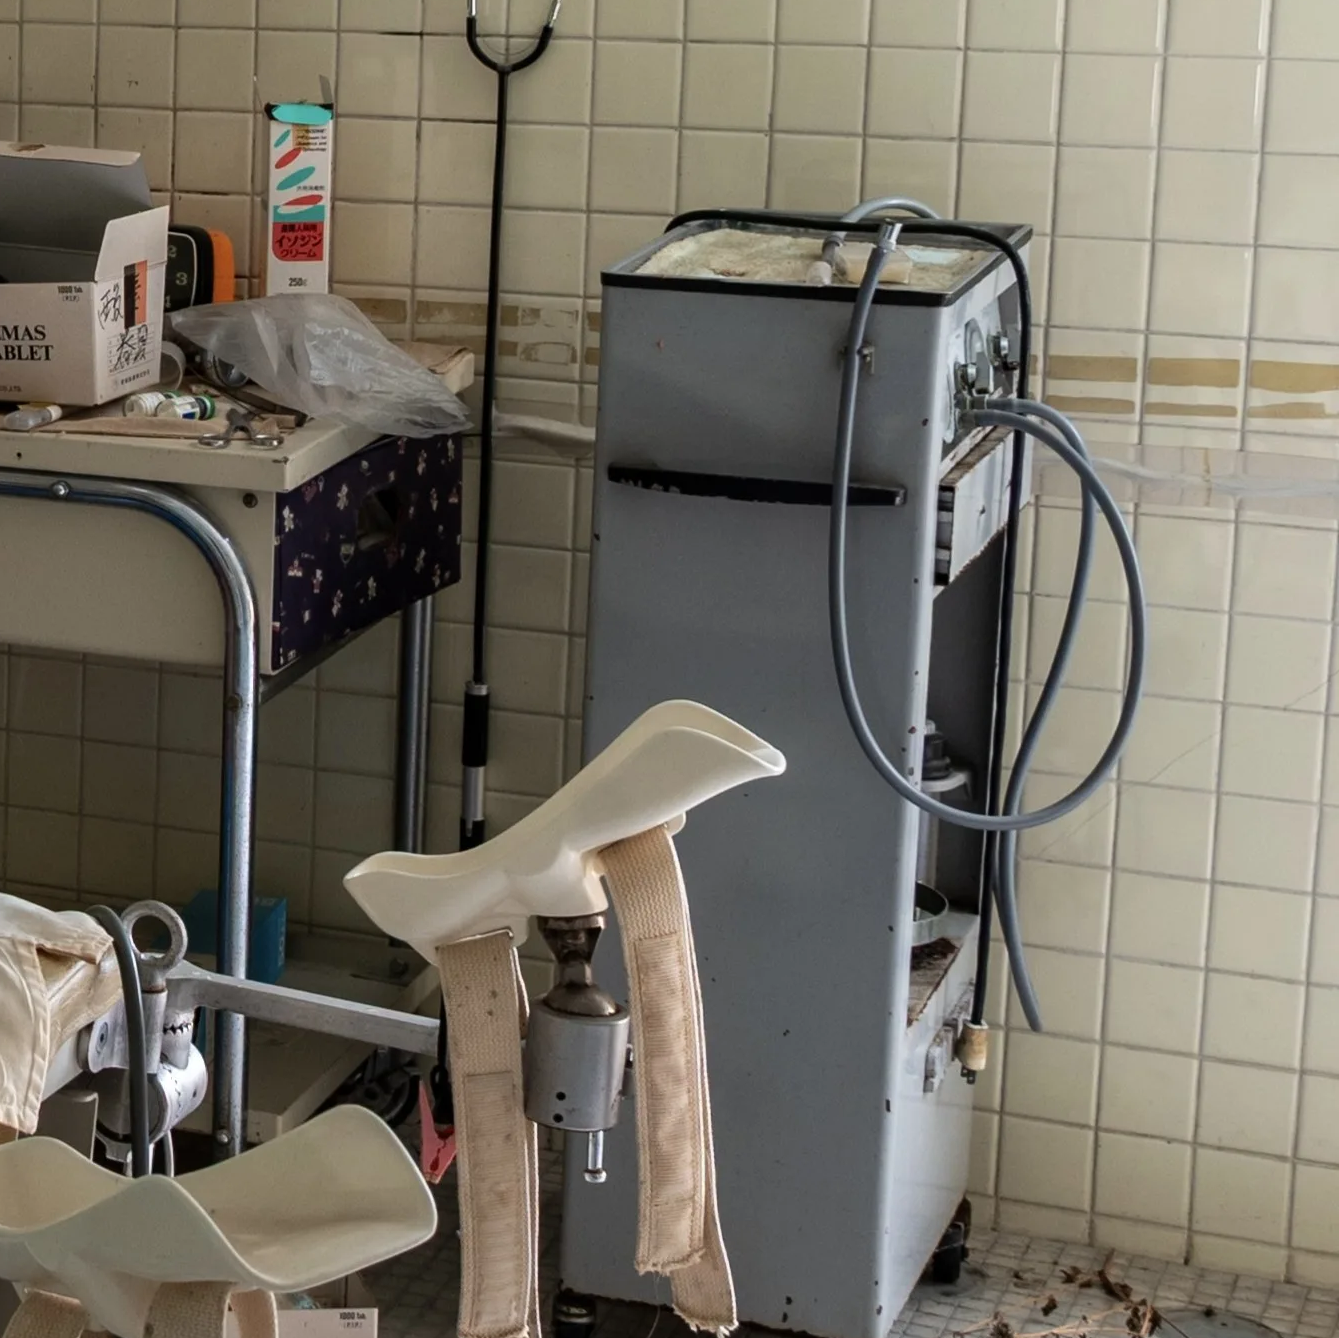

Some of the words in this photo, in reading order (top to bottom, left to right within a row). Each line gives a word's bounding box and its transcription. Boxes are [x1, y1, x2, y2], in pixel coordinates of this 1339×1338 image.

[275, 233, 323, 248] イソジン
[175, 271, 188, 286] 3
